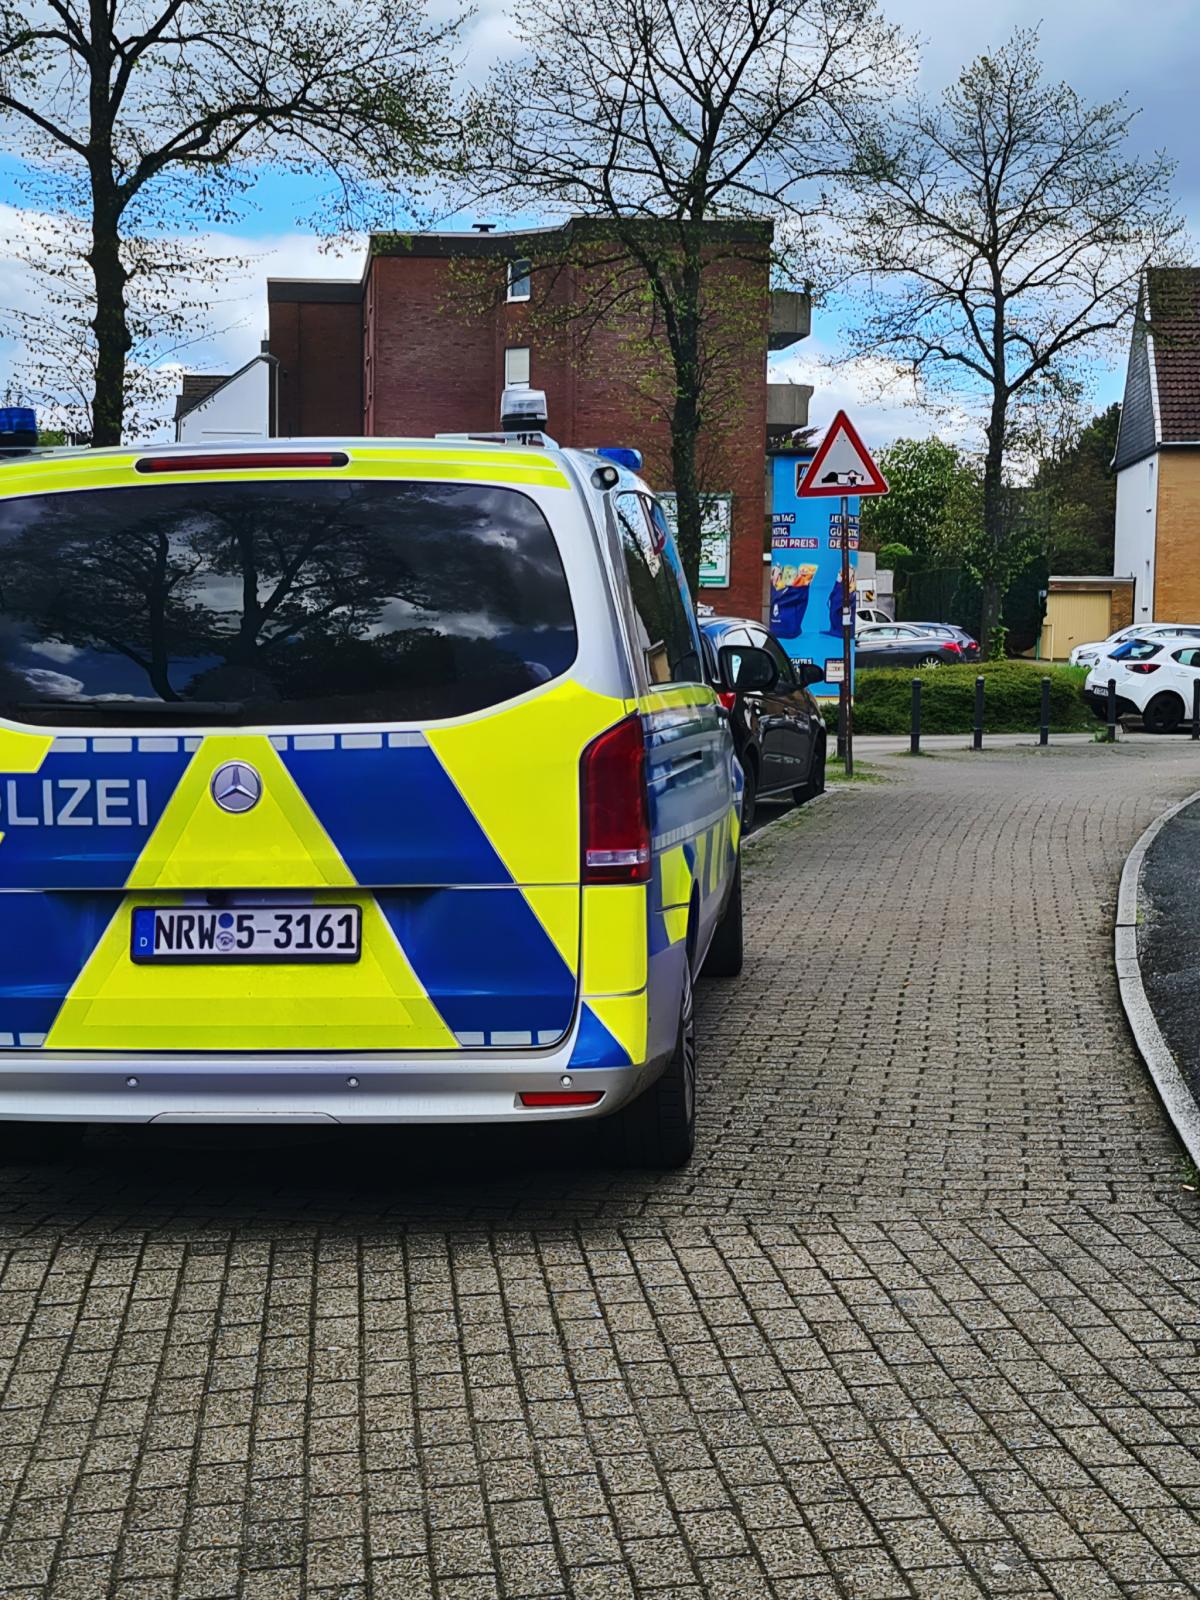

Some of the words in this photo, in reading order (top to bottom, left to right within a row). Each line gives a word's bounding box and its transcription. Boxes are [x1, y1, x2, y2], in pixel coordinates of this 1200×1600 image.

[781, 514, 794, 523] TAG
[789, 538, 816, 548] PREIS.
[139, 936, 148, 947] D
[154, 914, 217, 950] NRW
[235, 913, 356, 949] 5-3161
